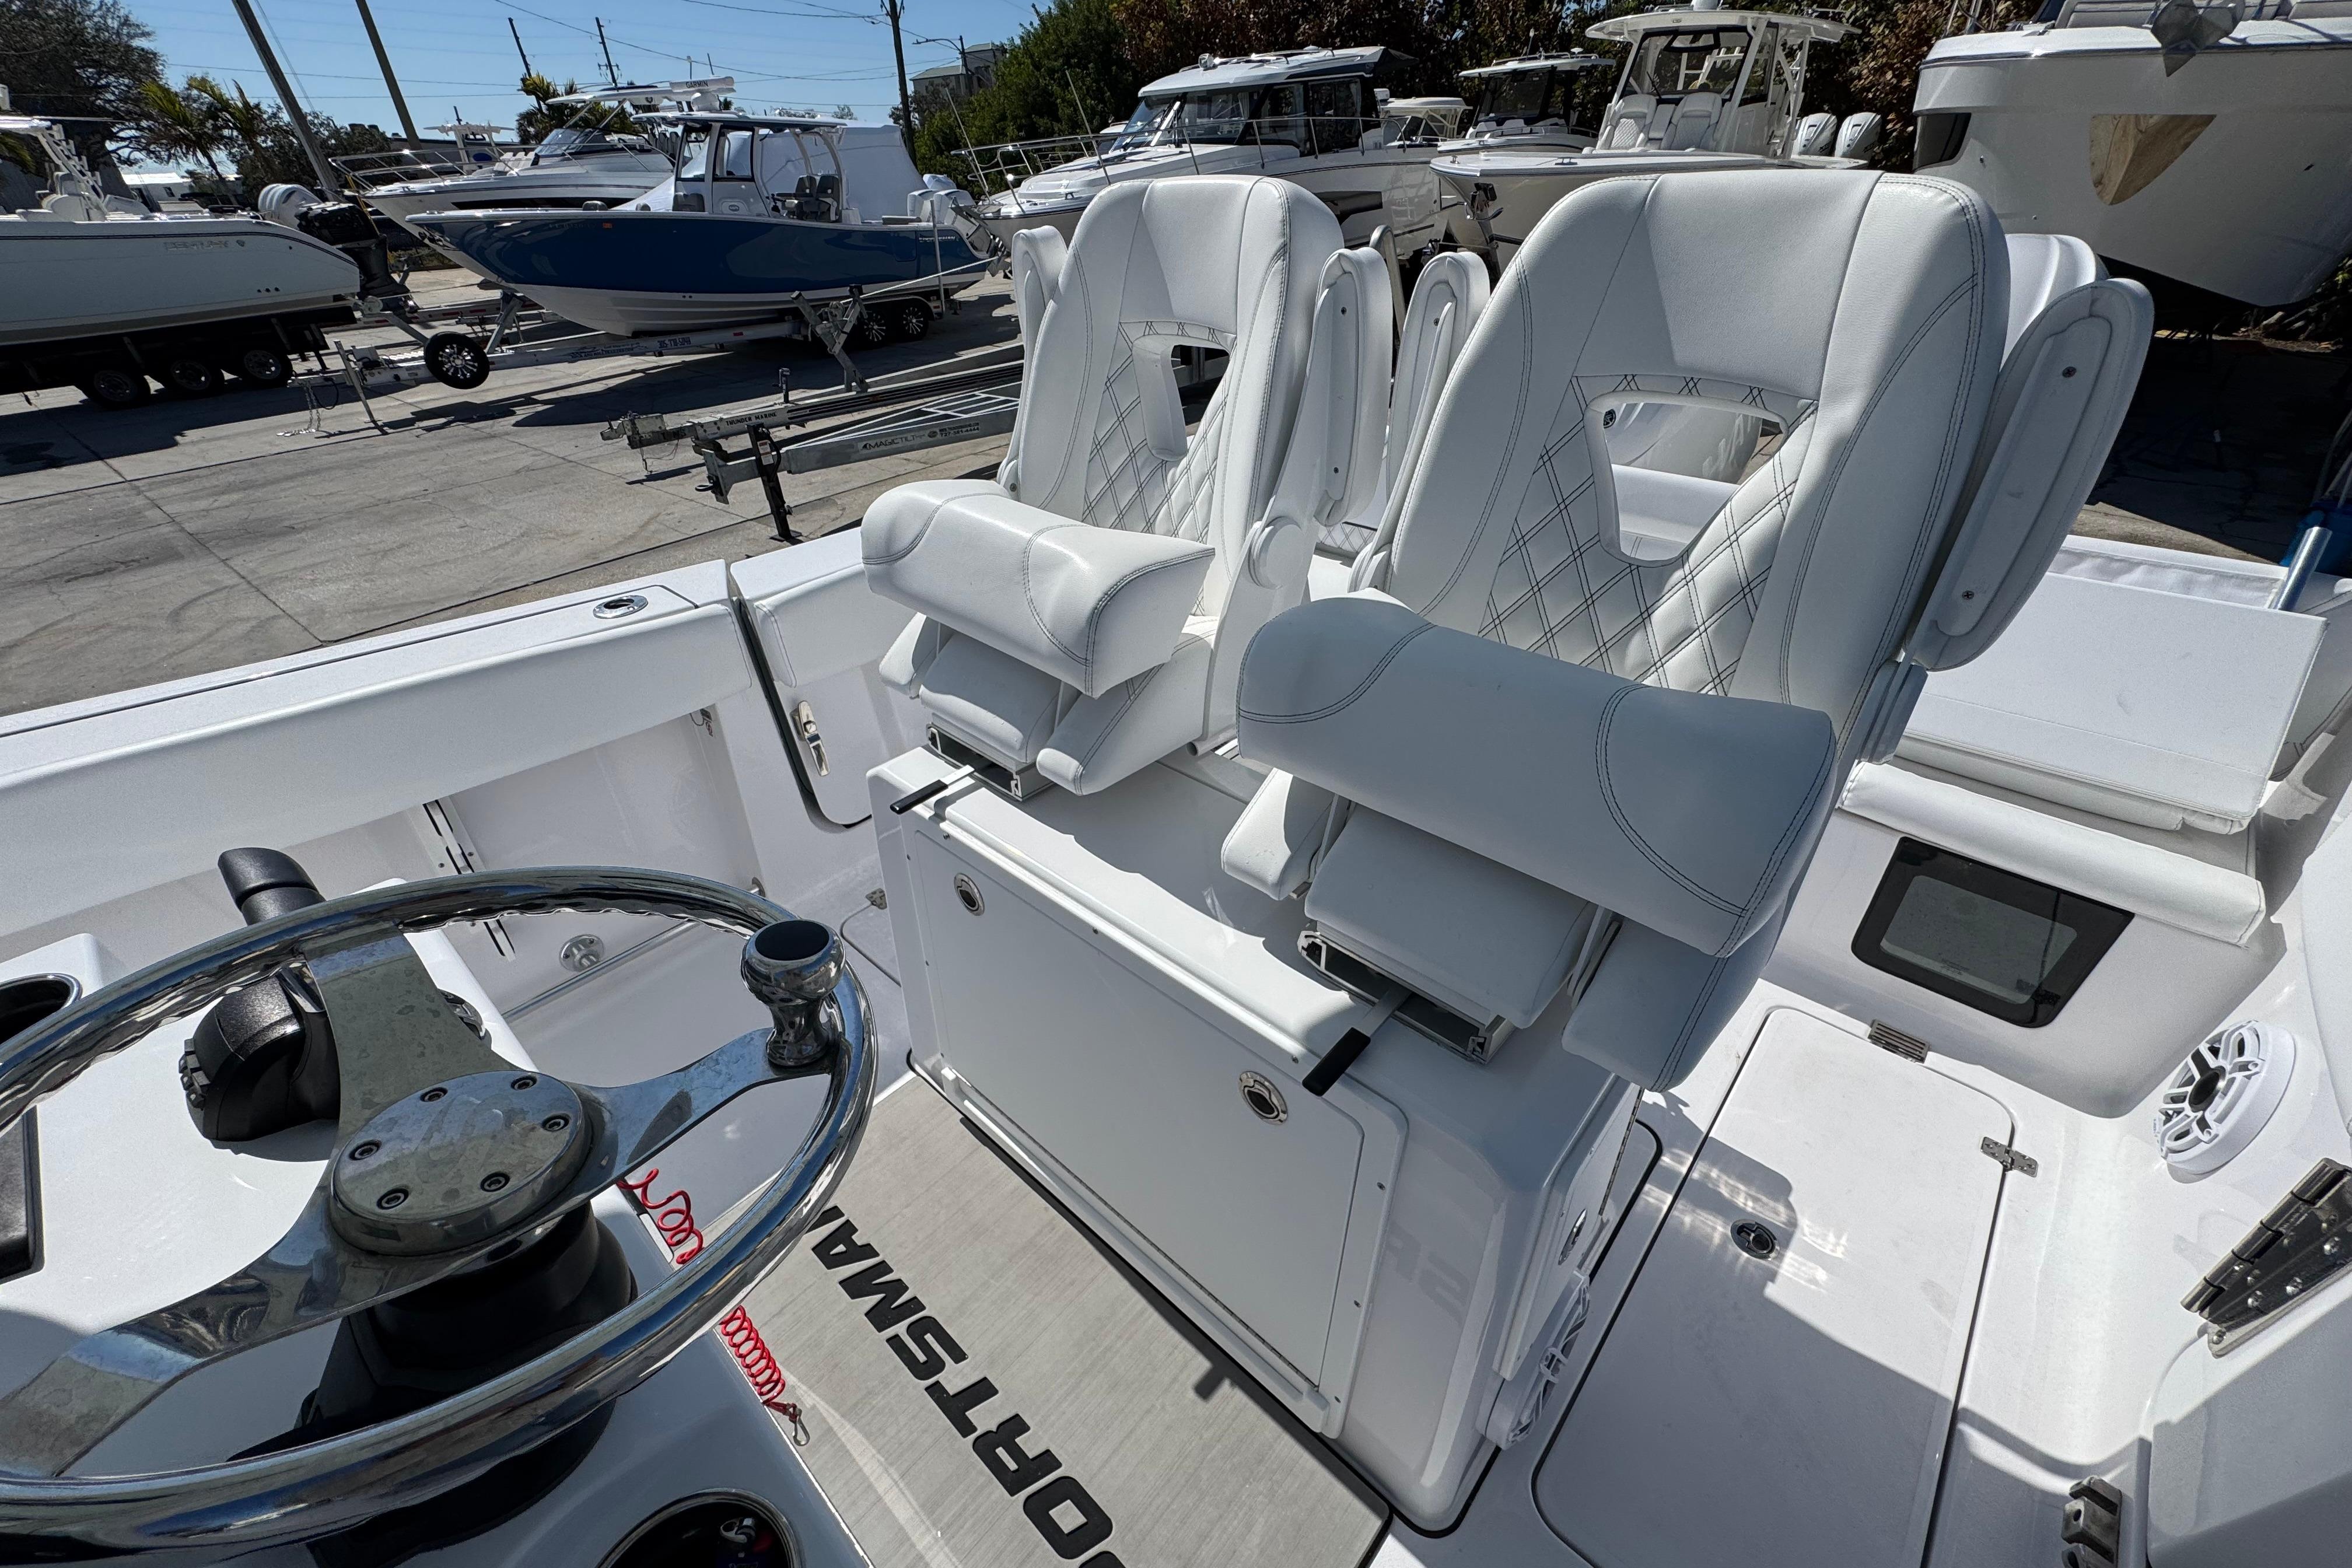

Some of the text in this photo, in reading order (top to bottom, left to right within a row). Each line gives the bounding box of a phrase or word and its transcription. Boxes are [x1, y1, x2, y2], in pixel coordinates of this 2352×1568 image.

[685, 80, 709, 89] GARMIN
[726, 412, 776, 426] THUNDER MARINE
[866, 435, 915, 450] MAGICTILT
[806, 1206, 1126, 1568] ORTSMA
